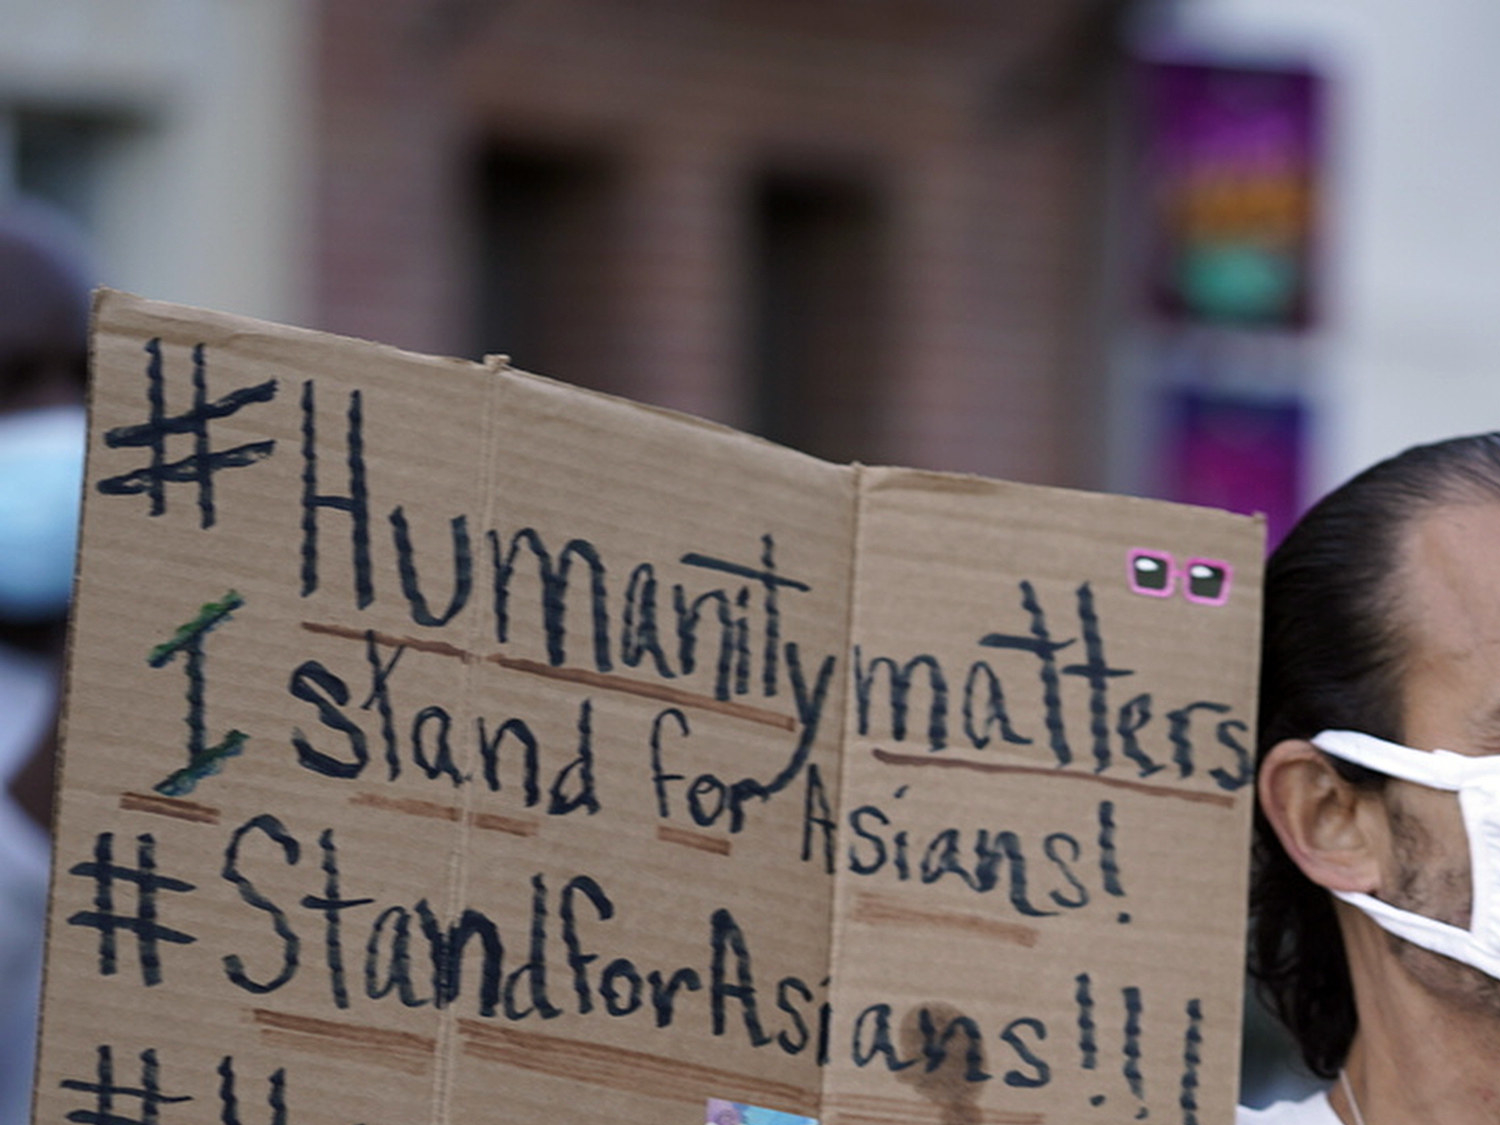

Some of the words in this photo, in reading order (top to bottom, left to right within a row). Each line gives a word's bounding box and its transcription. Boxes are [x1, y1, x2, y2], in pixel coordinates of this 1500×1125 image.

[149, 588, 251, 796] I
[650, 708, 768, 833] for
[801, 763, 1132, 924] Asians!
